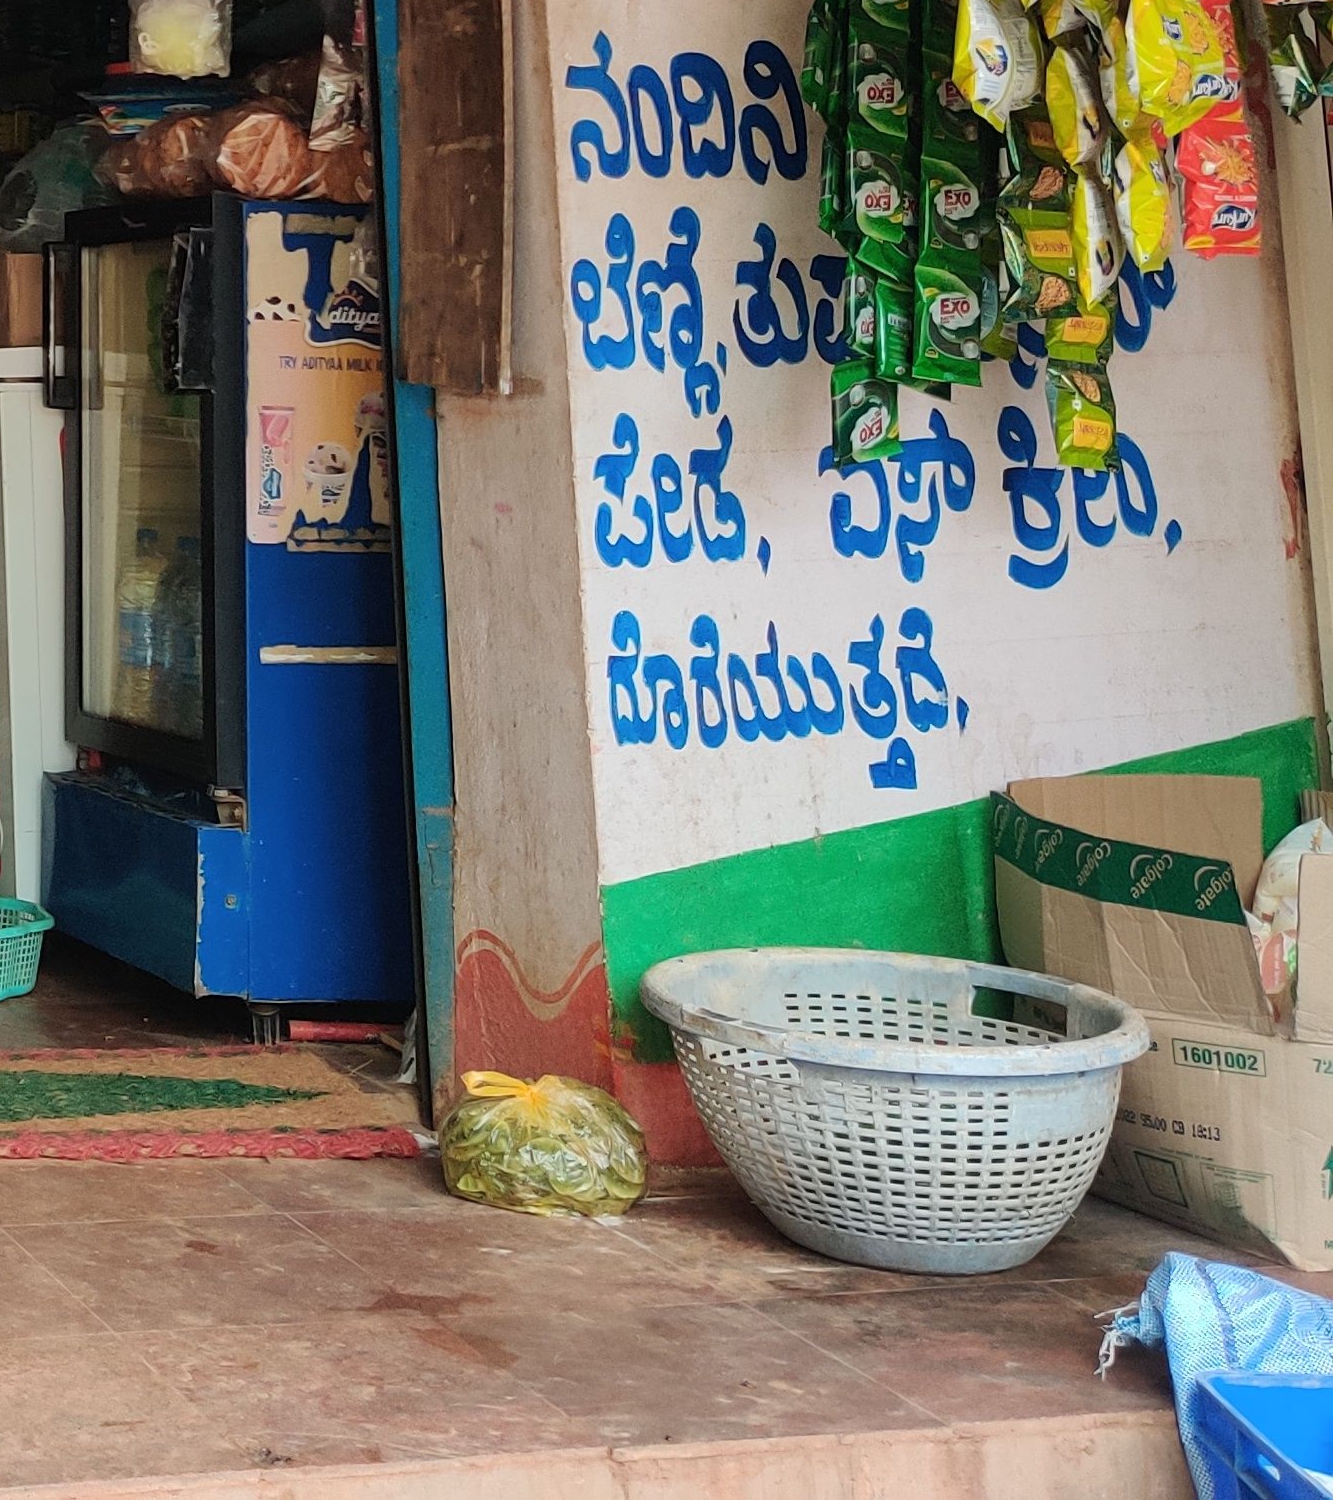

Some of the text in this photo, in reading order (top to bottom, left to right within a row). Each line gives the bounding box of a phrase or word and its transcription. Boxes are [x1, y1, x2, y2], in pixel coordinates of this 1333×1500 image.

[565, 30, 808, 183] ನಂದಿನಿ
[279, 355, 297, 369] TRY
[1076, 840, 1112, 887] Colgate
[1130, 852, 1175, 900] Colgate
[1180, 1045, 1259, 1072] 1601002
